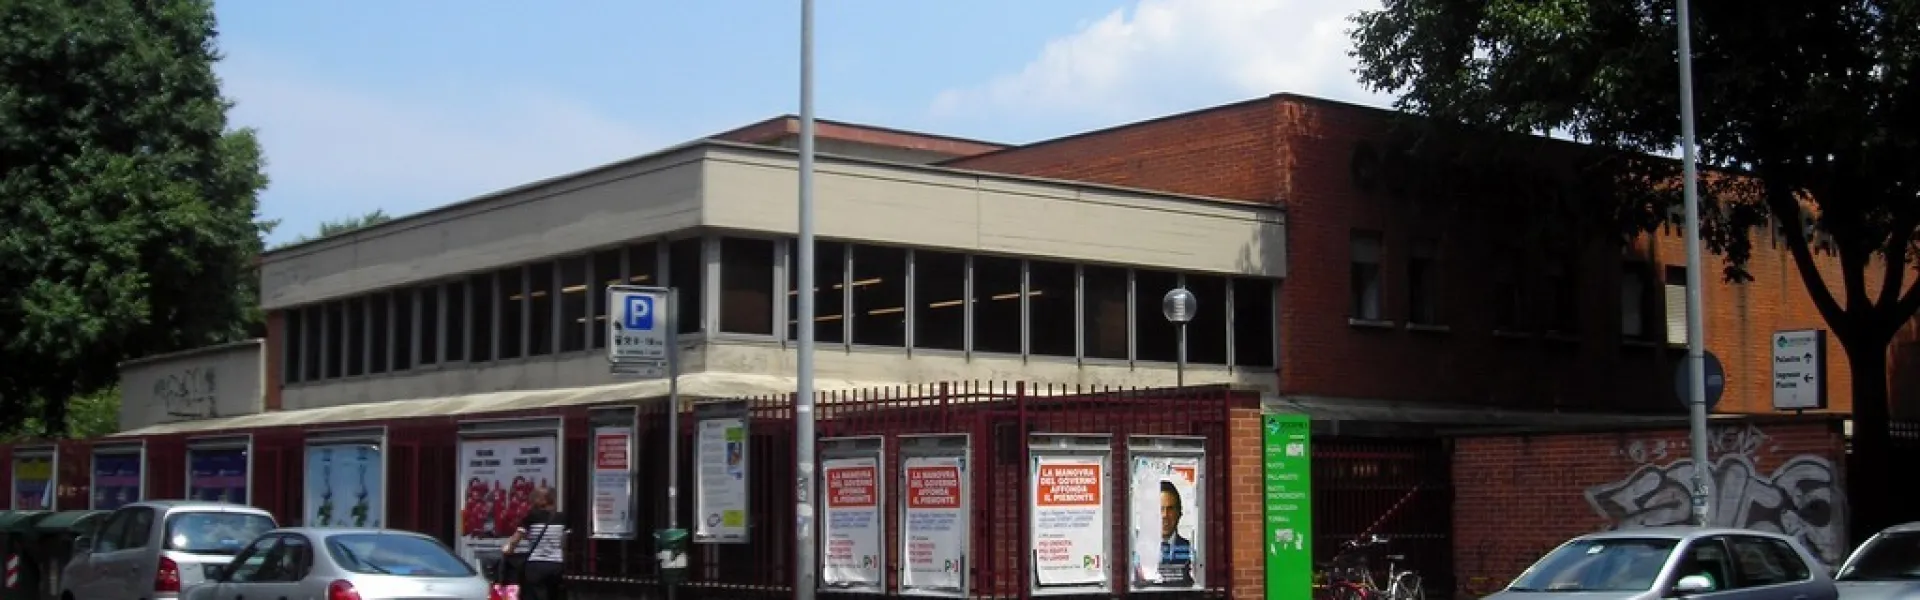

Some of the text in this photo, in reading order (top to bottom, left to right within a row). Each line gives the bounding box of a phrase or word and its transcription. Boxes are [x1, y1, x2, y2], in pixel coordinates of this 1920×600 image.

[631, 299, 649, 325] P
[1042, 468, 1094, 477] LA MANOVRA
[1040, 477, 1097, 485] DEL GOVERNO
[1050, 485, 1088, 493] AFFONDA
[1043, 494, 1094, 502] IL PIEMONTE
